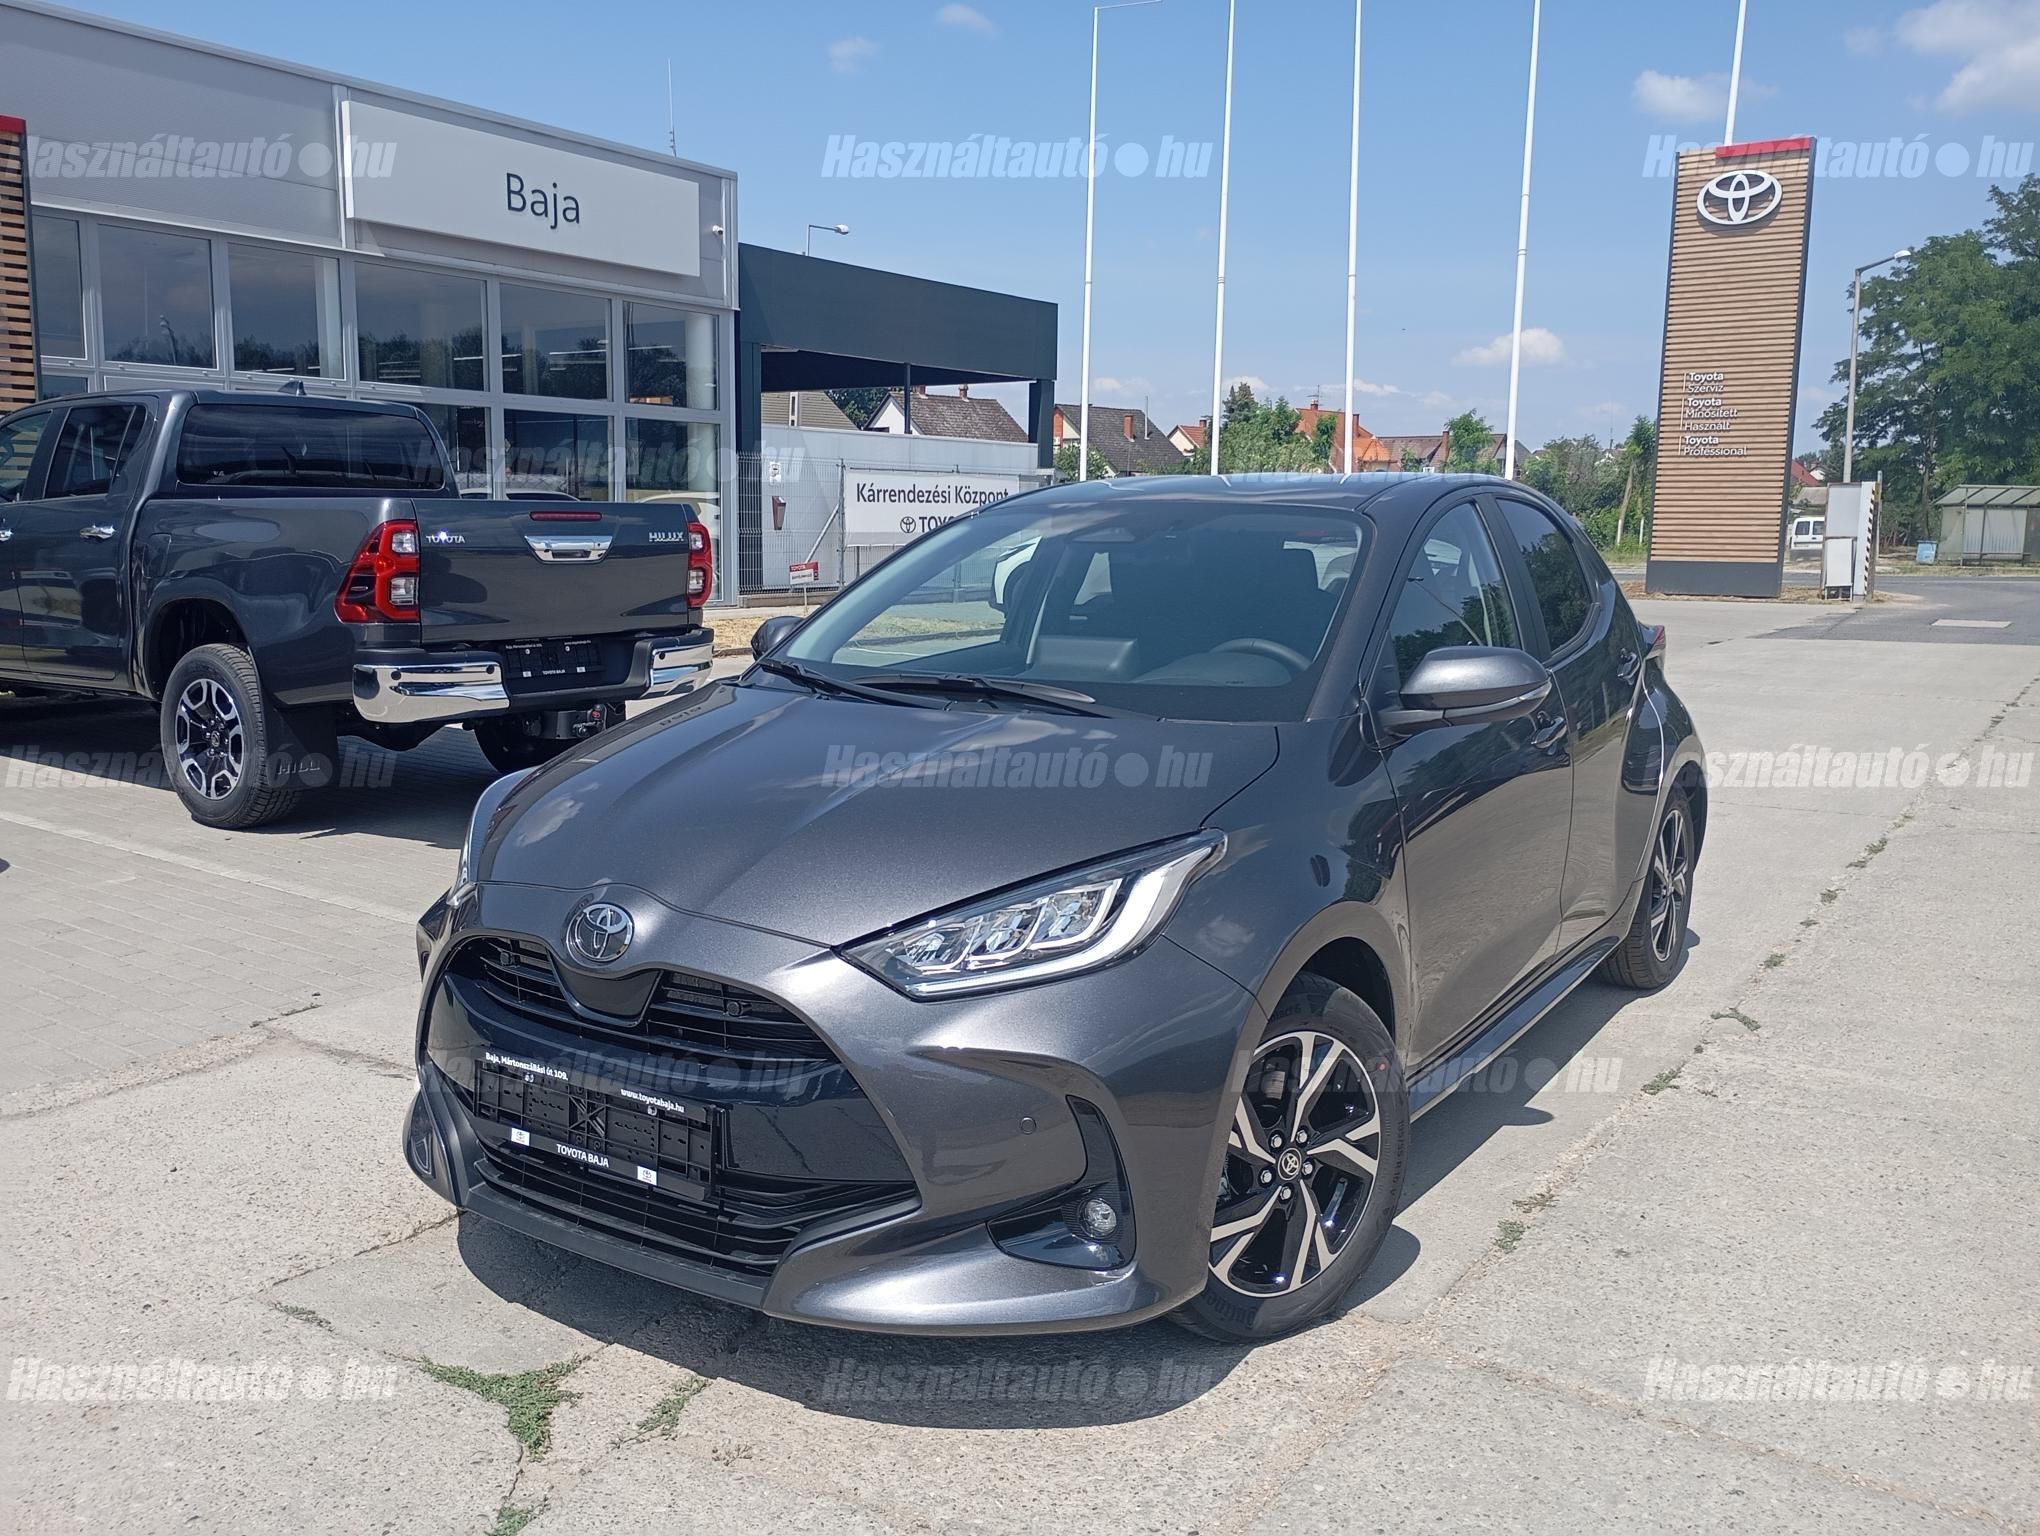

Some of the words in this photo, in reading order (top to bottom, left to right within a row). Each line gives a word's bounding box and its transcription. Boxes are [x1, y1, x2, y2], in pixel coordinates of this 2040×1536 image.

[506, 172, 580, 230] Baja
[1689, 371, 1724, 384] Toyota
[1687, 384, 1725, 393] Szerviz
[1687, 397, 1722, 408] Toyota
[1684, 421, 1730, 431] Használt
[1685, 435, 1719, 446] Toyota
[1683, 445, 1747, 456] Professional
[856, 482, 951, 504] Kárrendezési
[954, 486, 1009, 506] Központ
[426, 533, 466, 544] TOYOTA
[649, 532, 684, 542] HILUX
[620, 1088, 685, 1113] www.toyotabaja.hu
[556, 1143, 587, 1162] TOYOTA
[588, 1153, 609, 1168] BAJA
